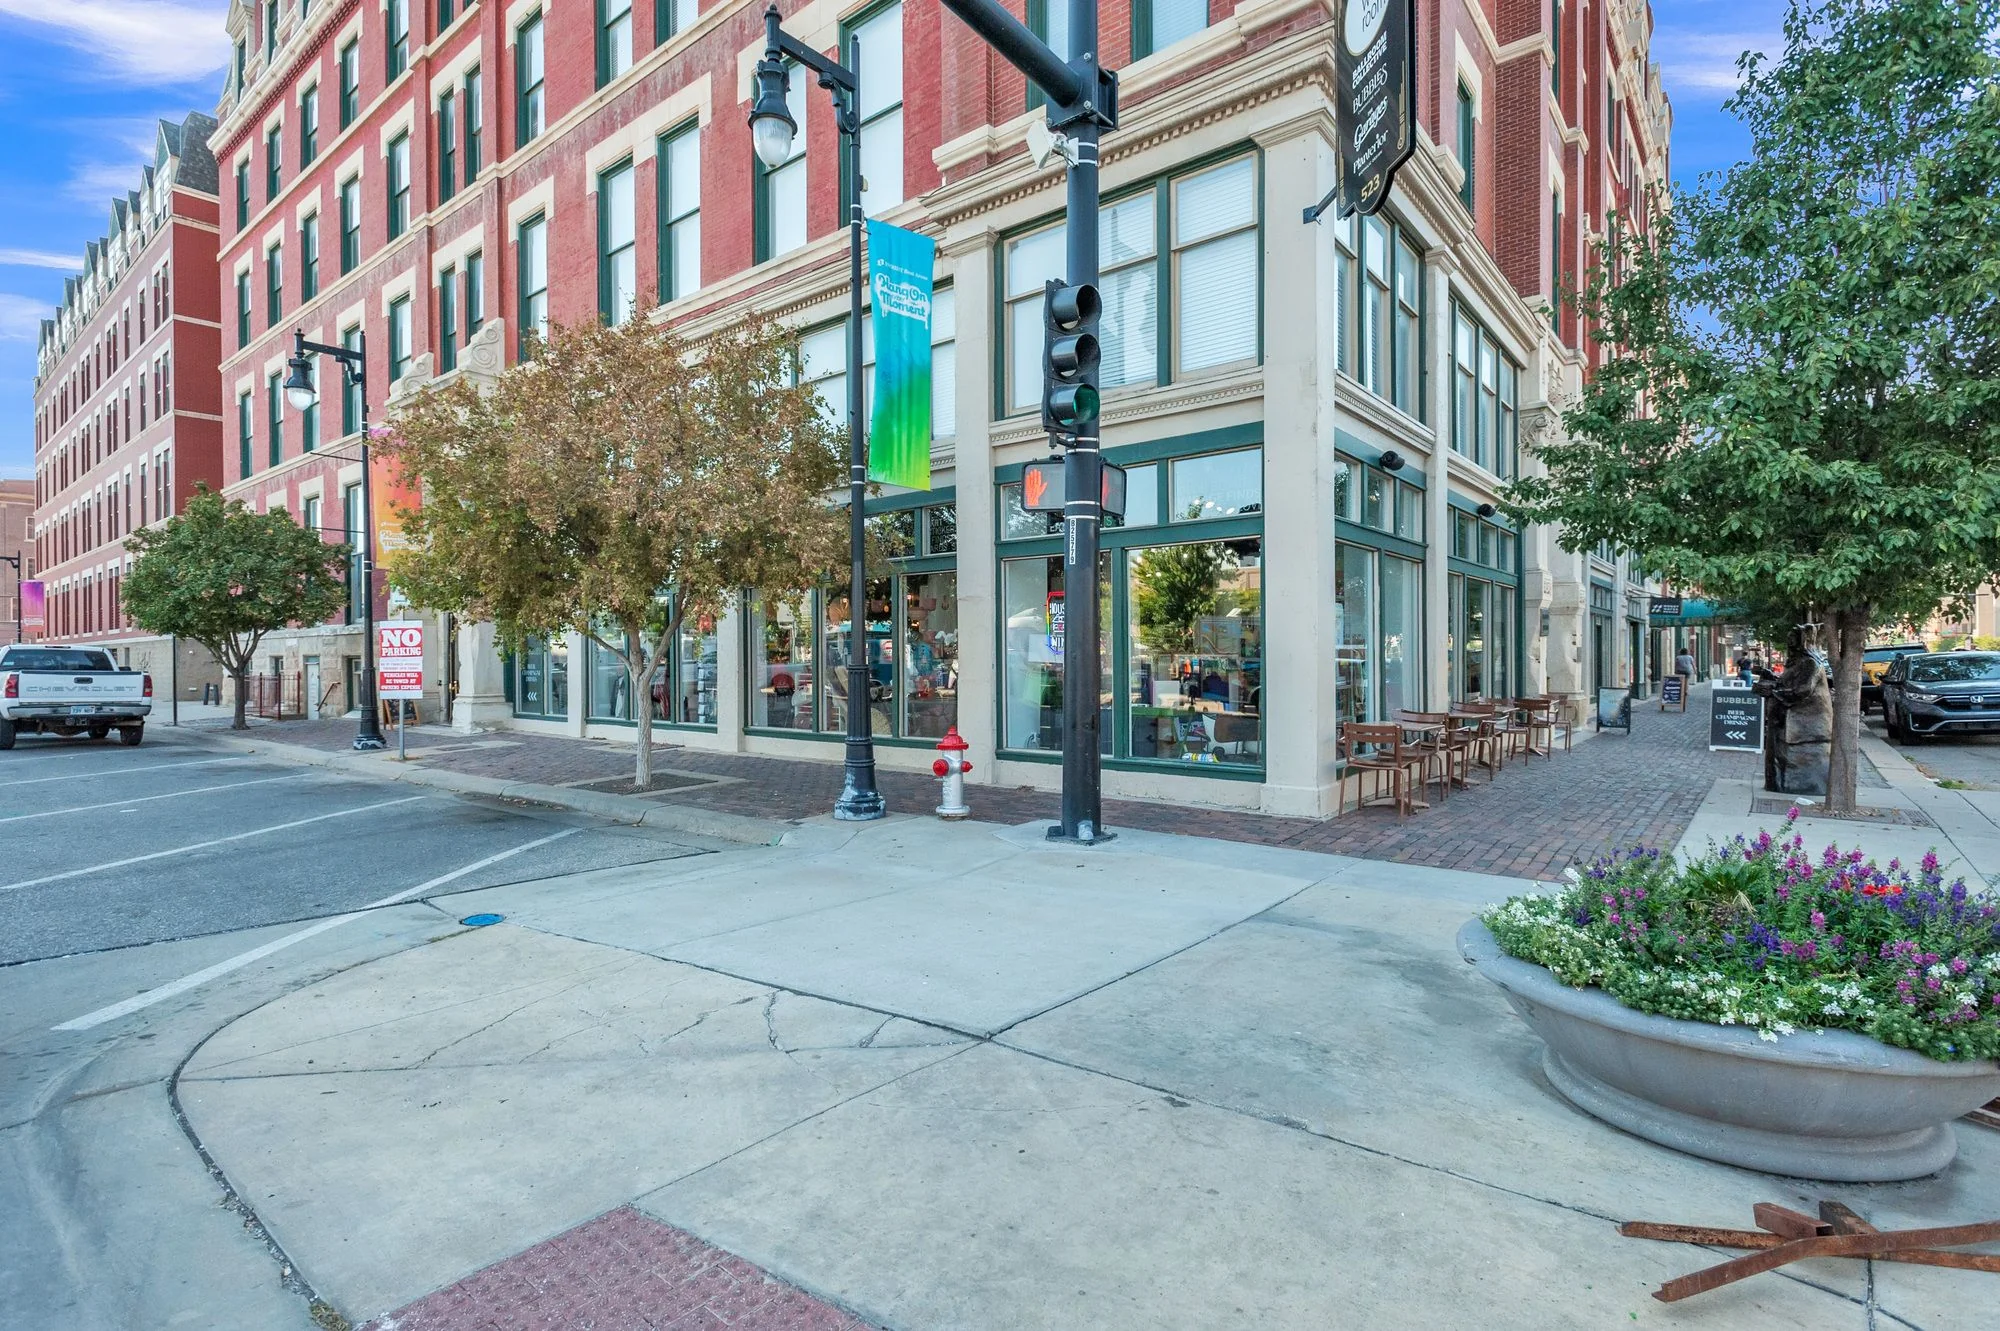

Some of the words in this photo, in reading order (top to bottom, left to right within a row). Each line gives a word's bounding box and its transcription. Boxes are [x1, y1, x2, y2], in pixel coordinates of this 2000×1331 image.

[1352, 31, 1387, 79] BALLROOM
[1352, 41, 1388, 89] COLLECTIVE
[1352, 62, 1388, 114] BUBBLES
[1354, 96, 1388, 151] Garages
[1353, 130, 1389, 174] Planterior
[1361, 173, 1380, 203] 523
[878, 274, 909, 300] Hang
[909, 288, 926, 302] On
[880, 289, 926, 317] Moment
[1049, 602, 1065, 615] HOUS
[381, 629, 422, 647] NO
[381, 647, 422, 657] PARKING
[1716, 696, 1758, 705] BUBBLES
